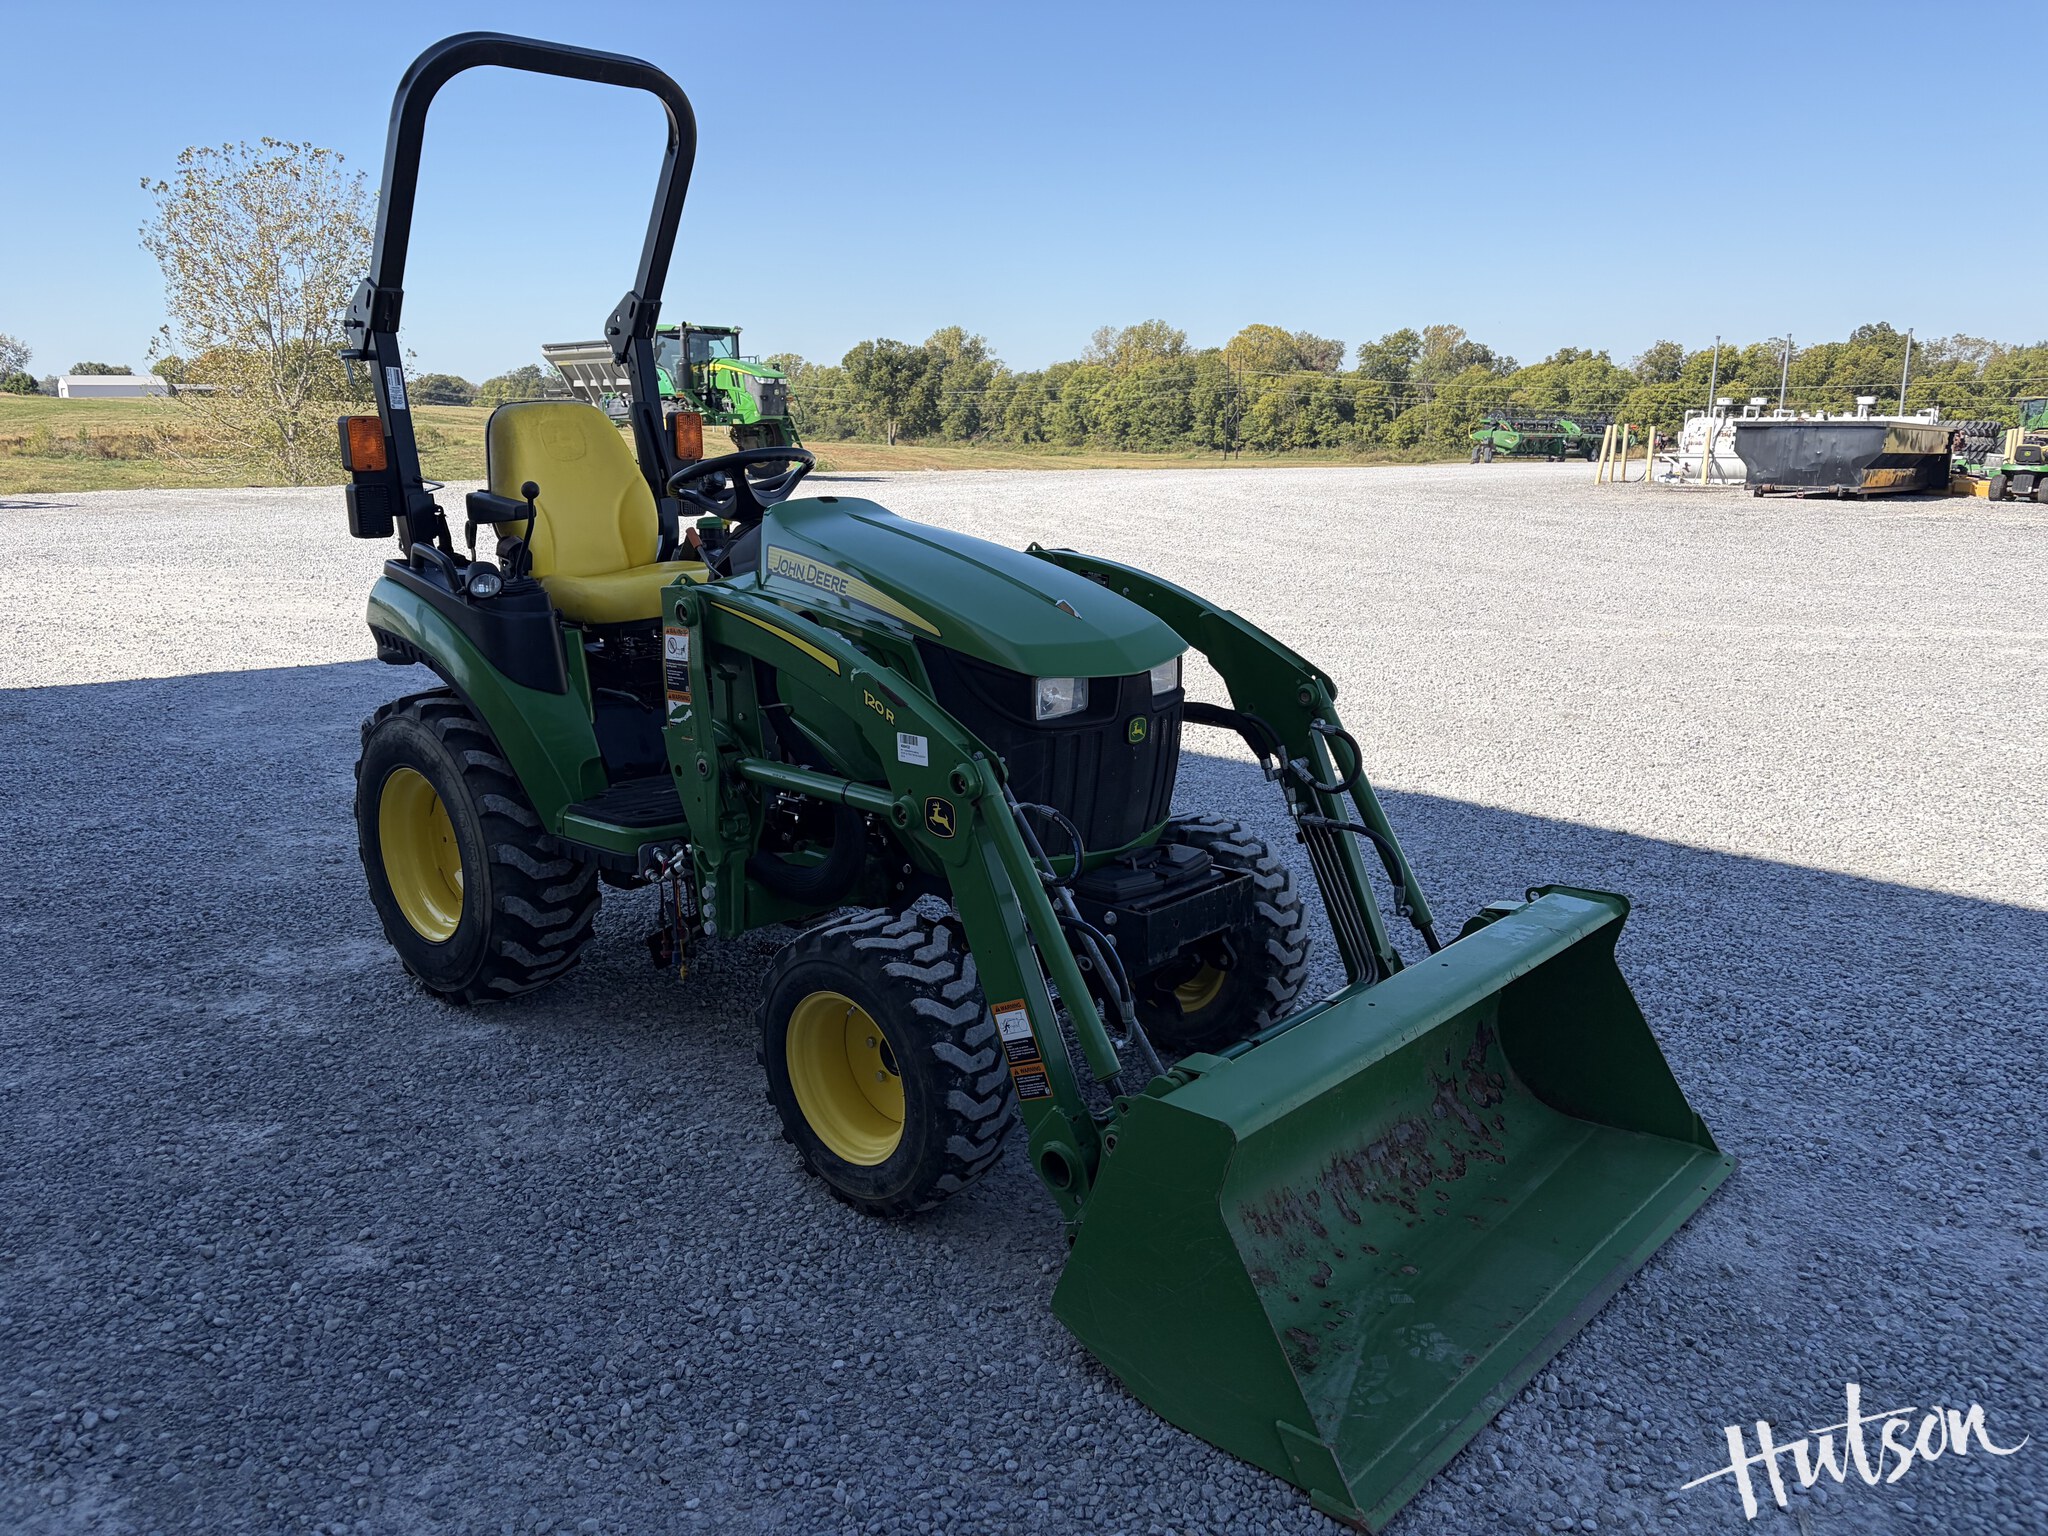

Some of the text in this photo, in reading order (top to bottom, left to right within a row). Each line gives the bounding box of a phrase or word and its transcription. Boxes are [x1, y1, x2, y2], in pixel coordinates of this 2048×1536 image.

[773, 555, 849, 595] JOHN DEERE
[863, 689, 895, 726] 120 R
[1000, 1002, 1021, 1011] WARNING
[1020, 1065, 1041, 1073] WARNING
